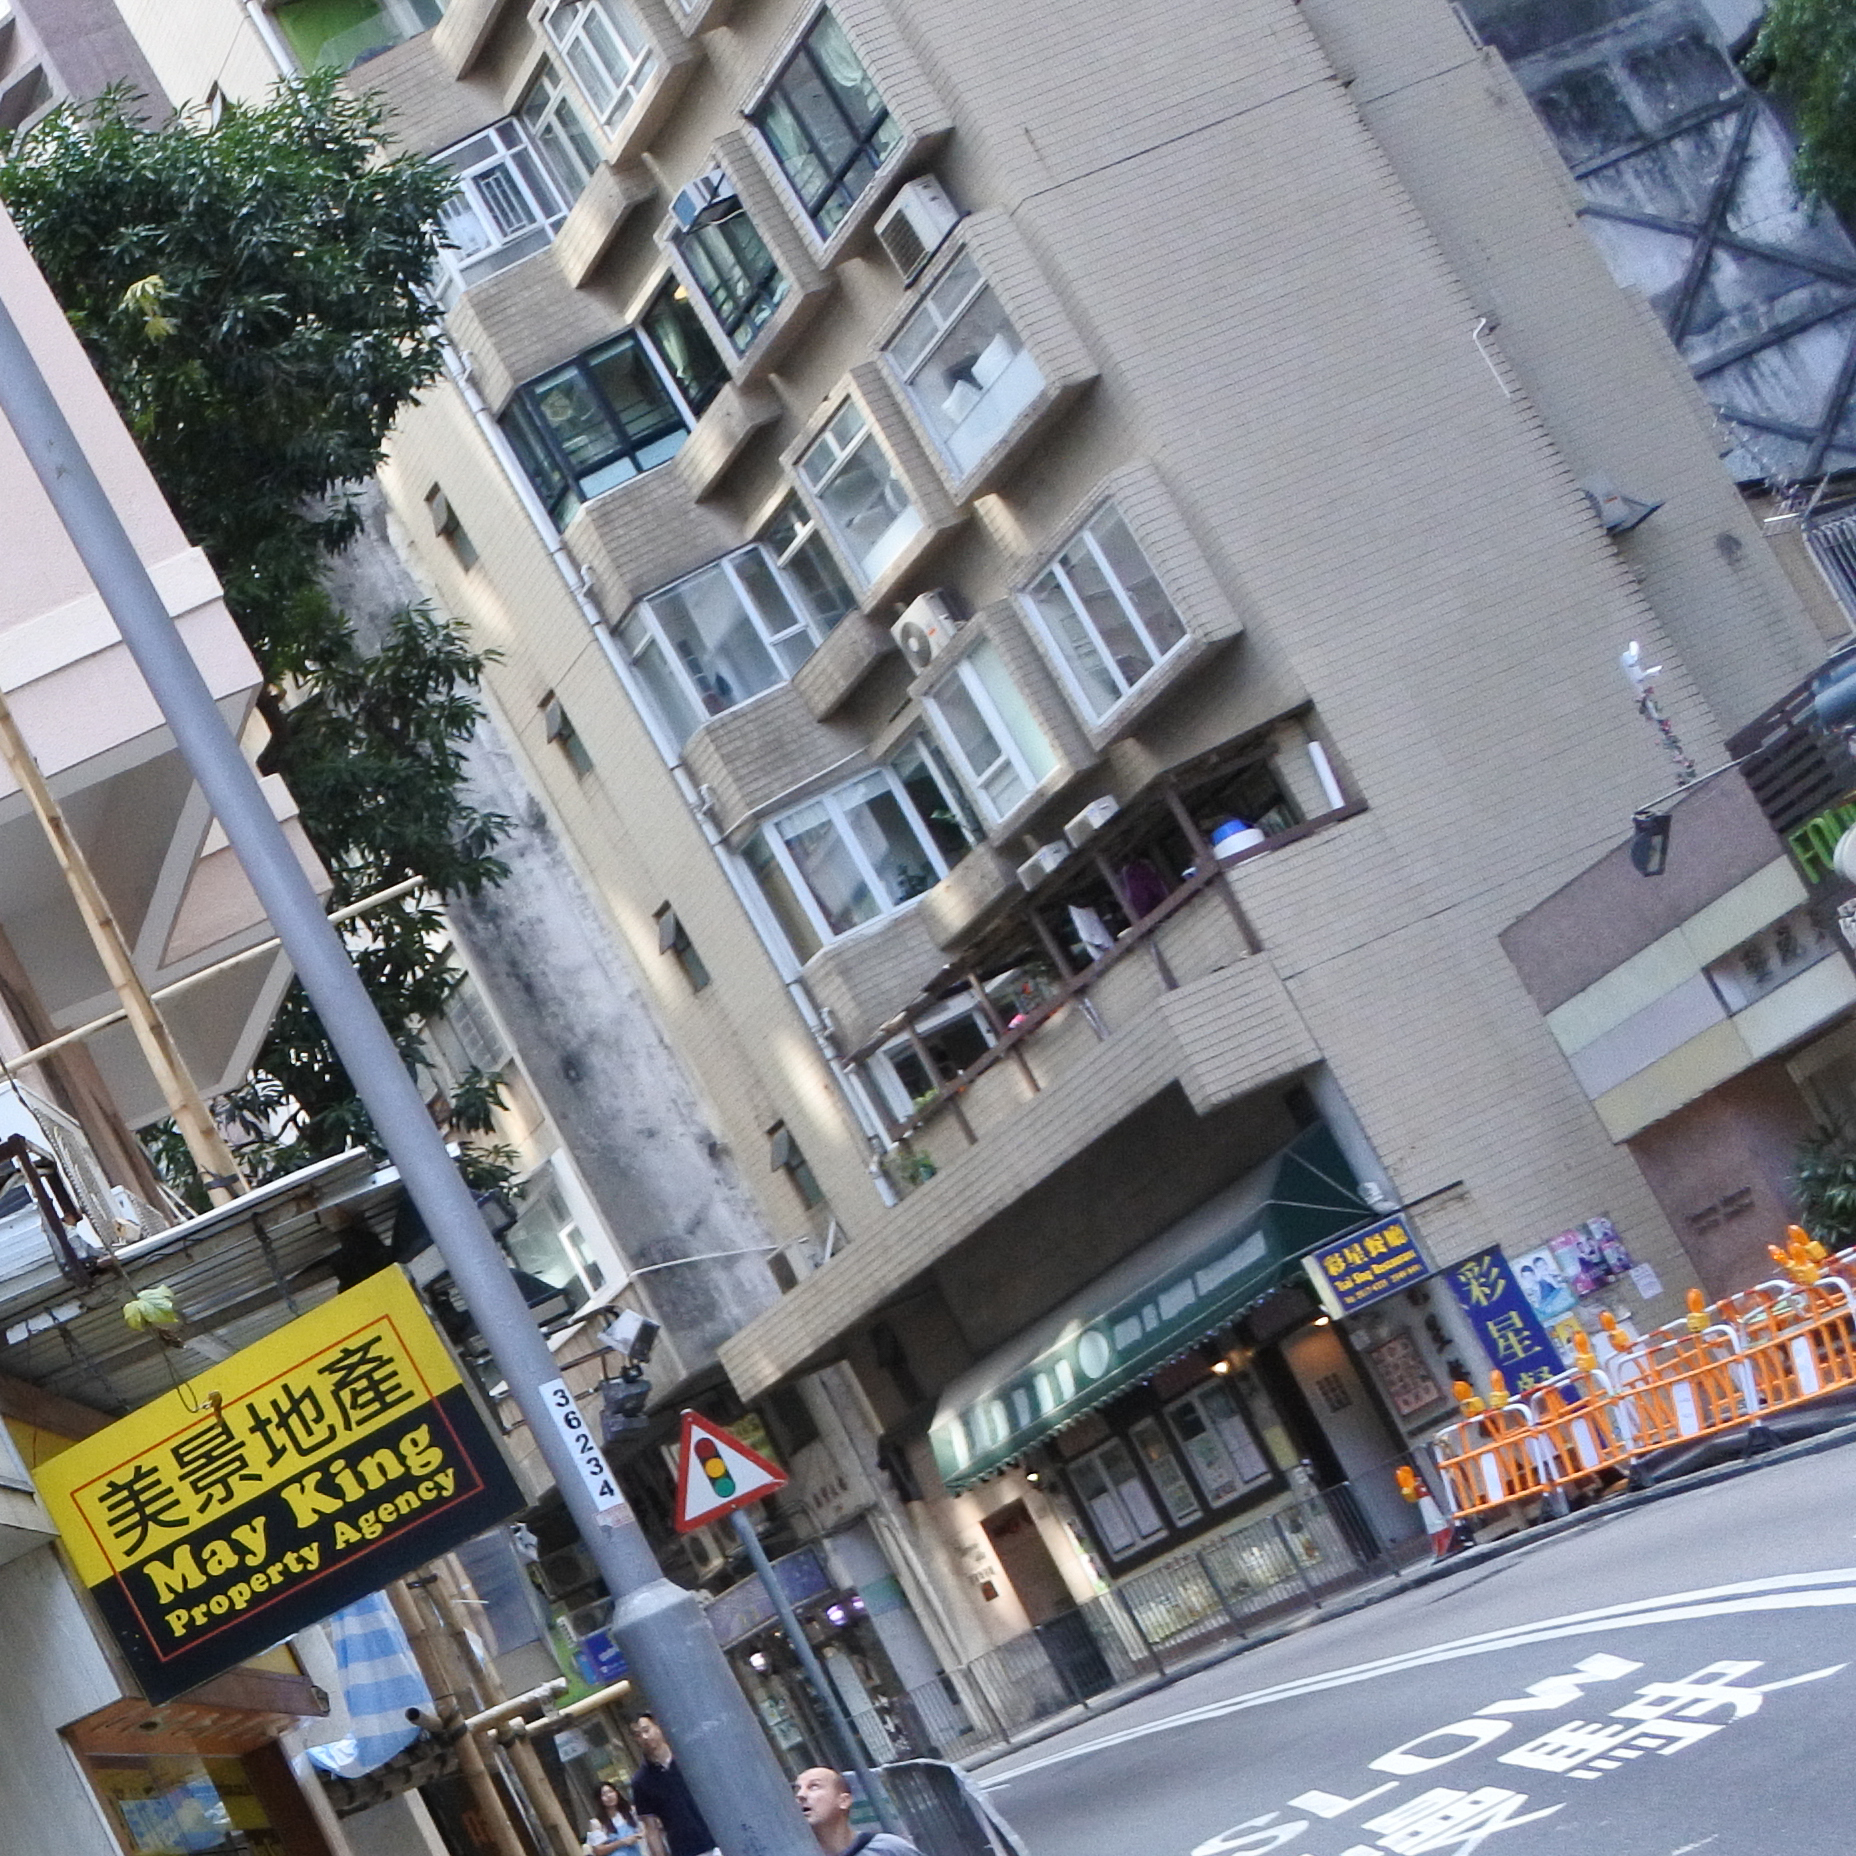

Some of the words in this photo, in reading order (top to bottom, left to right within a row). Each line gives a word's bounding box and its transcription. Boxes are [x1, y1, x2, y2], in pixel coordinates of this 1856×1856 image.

[96, 1333, 416, 1560] 美景地產
[141, 1512, 269, 1607] May
[278, 1422, 444, 1527] King
[164, 1540, 322, 1638] Property
[332, 1464, 458, 1552] Agency
